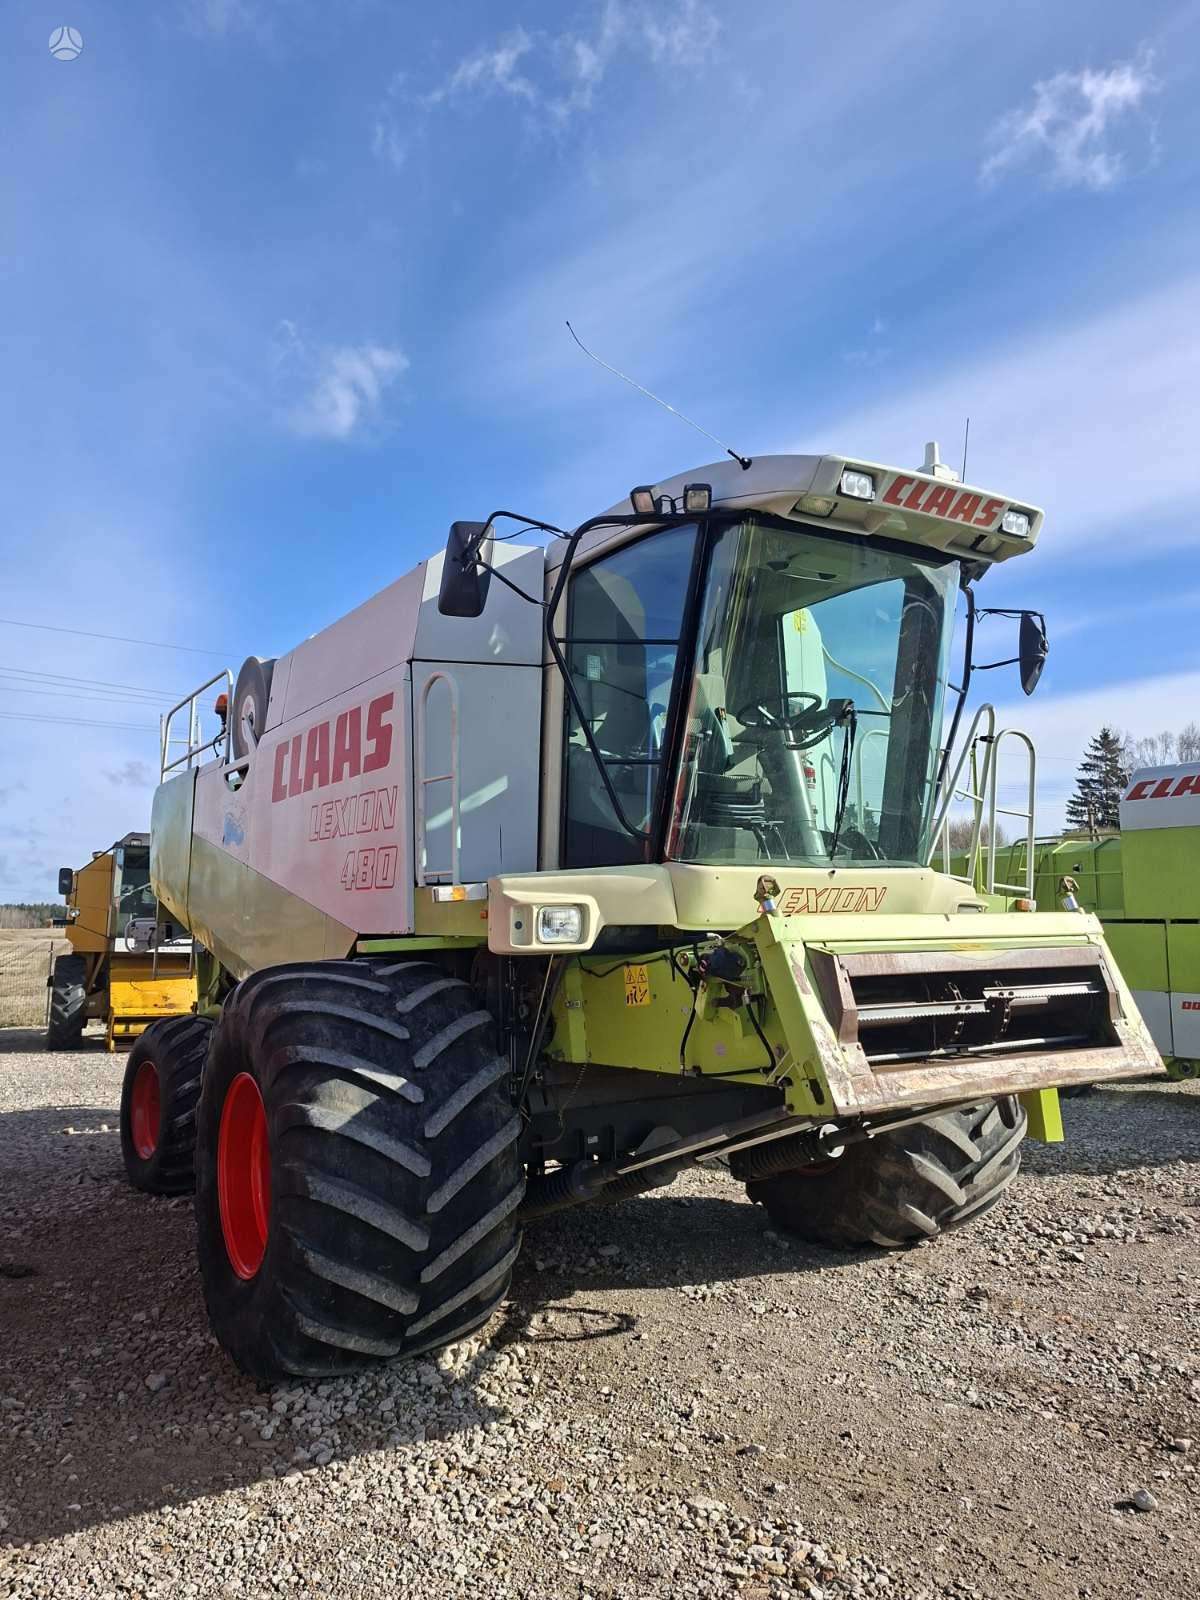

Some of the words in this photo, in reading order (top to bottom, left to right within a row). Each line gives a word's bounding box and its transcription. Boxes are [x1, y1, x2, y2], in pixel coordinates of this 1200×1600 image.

[882, 475, 1005, 527] CLAAS
[272, 692, 394, 803] CLAAS
[309, 786, 398, 841] LEXION
[341, 845, 398, 890] 480
[757, 886, 887, 913] EXION
